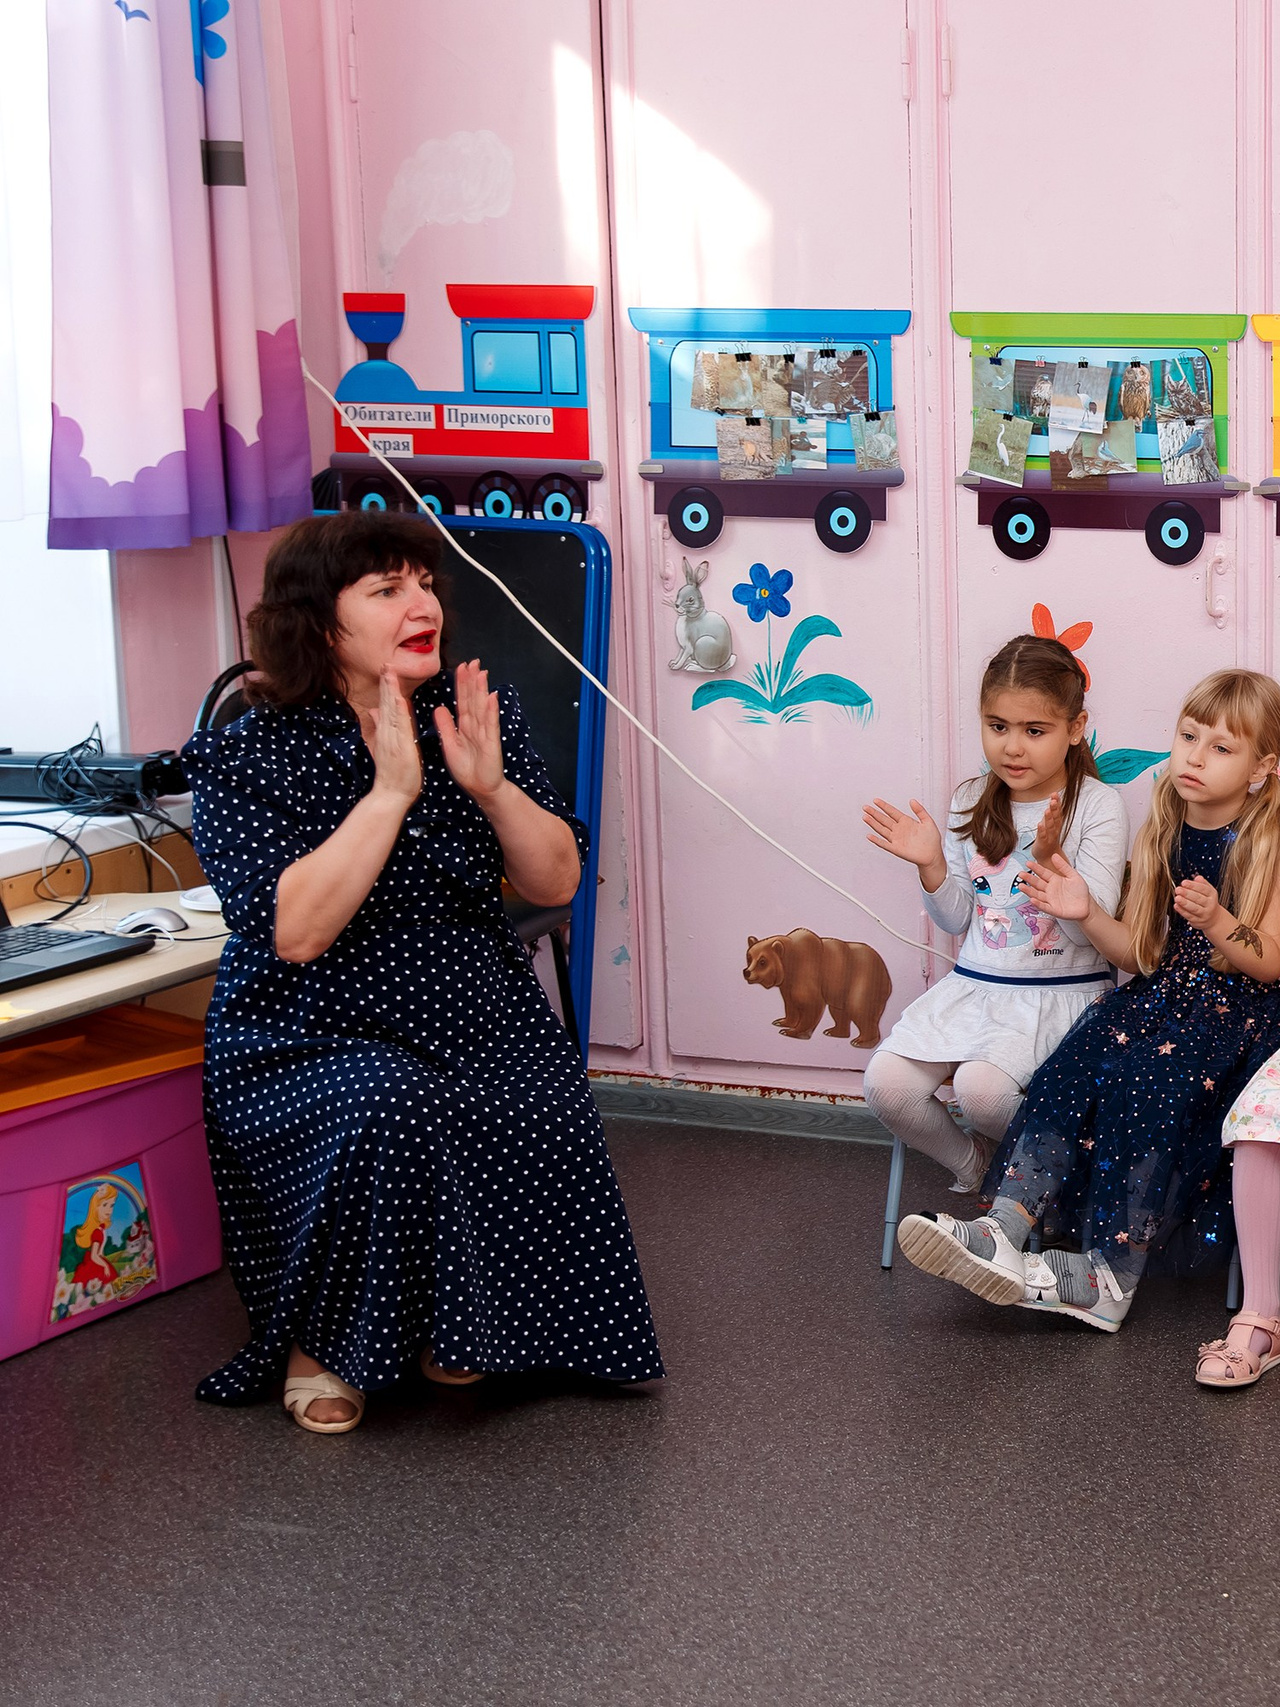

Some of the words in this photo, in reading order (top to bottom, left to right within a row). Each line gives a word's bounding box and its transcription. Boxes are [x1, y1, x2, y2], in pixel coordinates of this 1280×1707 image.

[344, 404, 432, 422] Обитатели
[447, 408, 551, 429] Приморского
[372, 439, 411, 457] края
